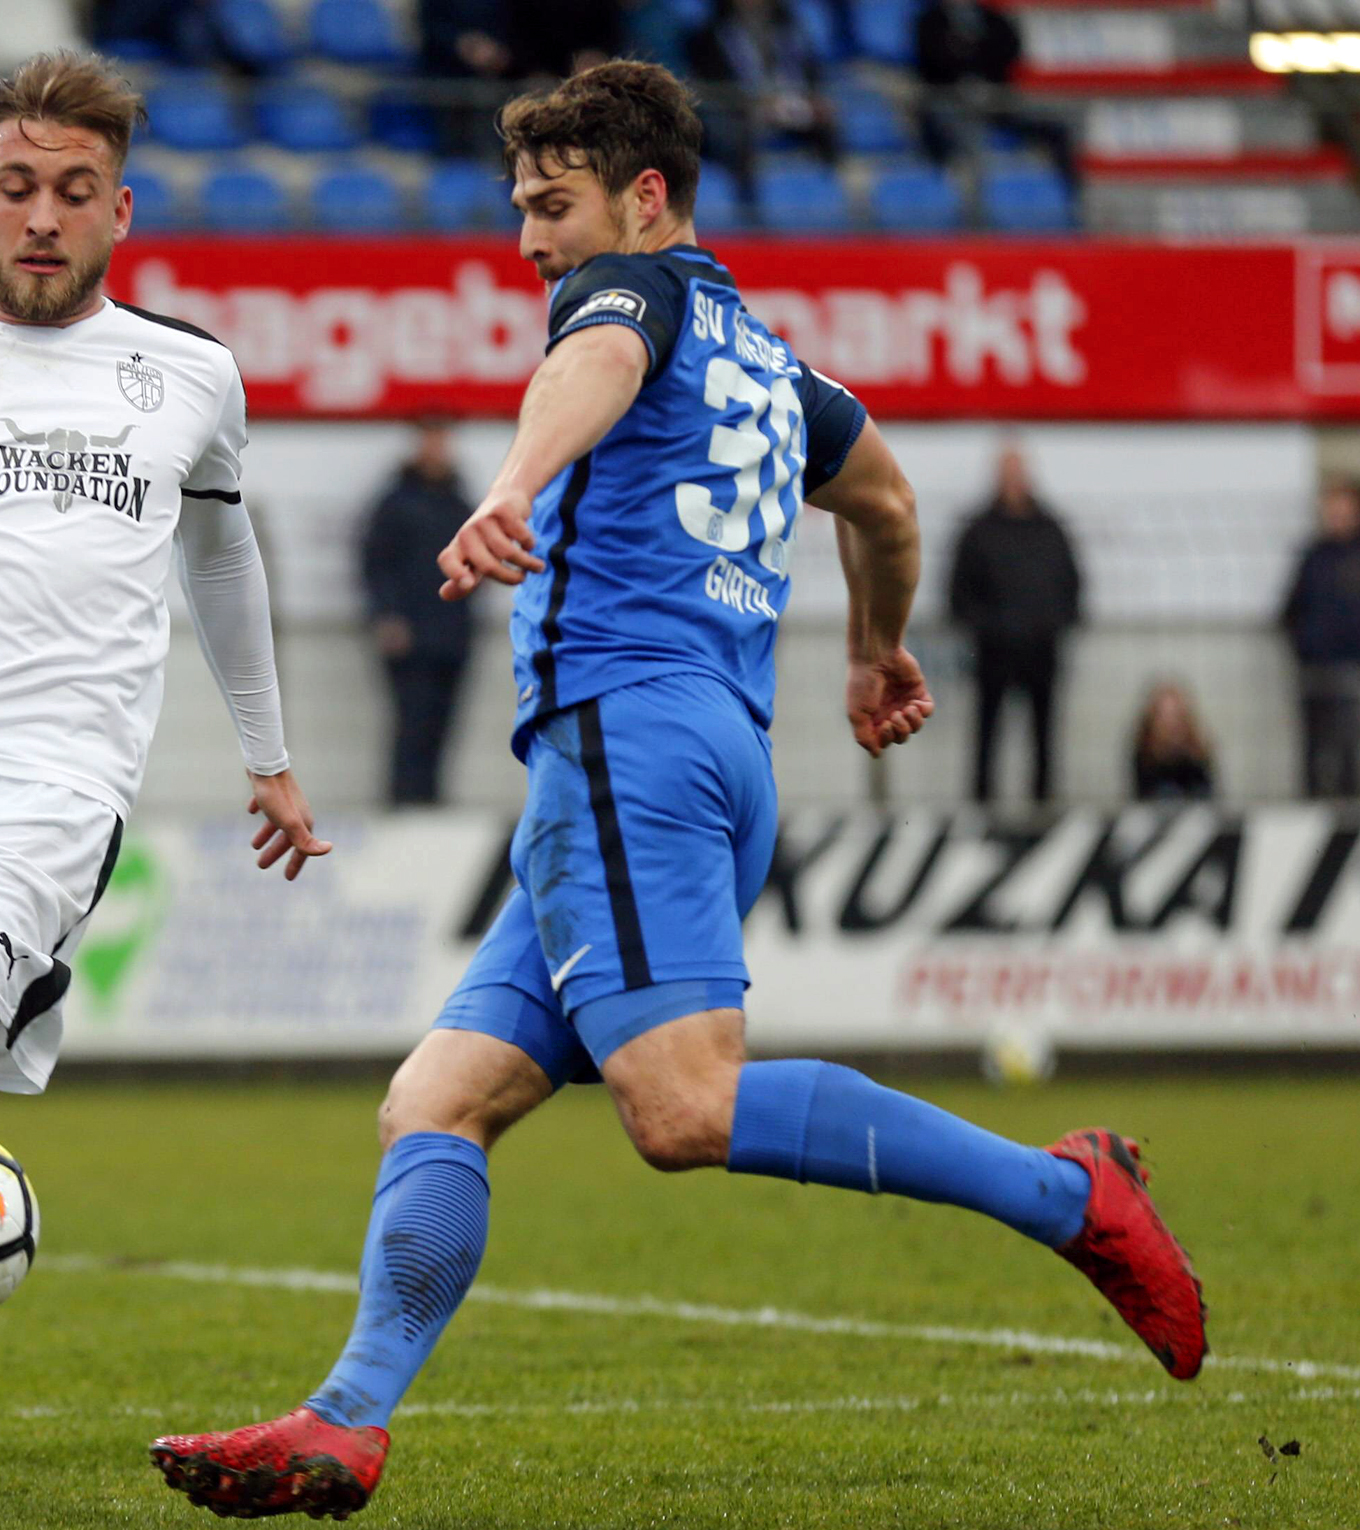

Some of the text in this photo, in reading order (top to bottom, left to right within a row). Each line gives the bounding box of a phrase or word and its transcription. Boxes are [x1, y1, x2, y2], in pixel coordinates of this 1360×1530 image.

[692, 289, 727, 346] SV
[675, 356, 807, 581] 30
[896, 952, 1360, 1010] PERFORMANC
